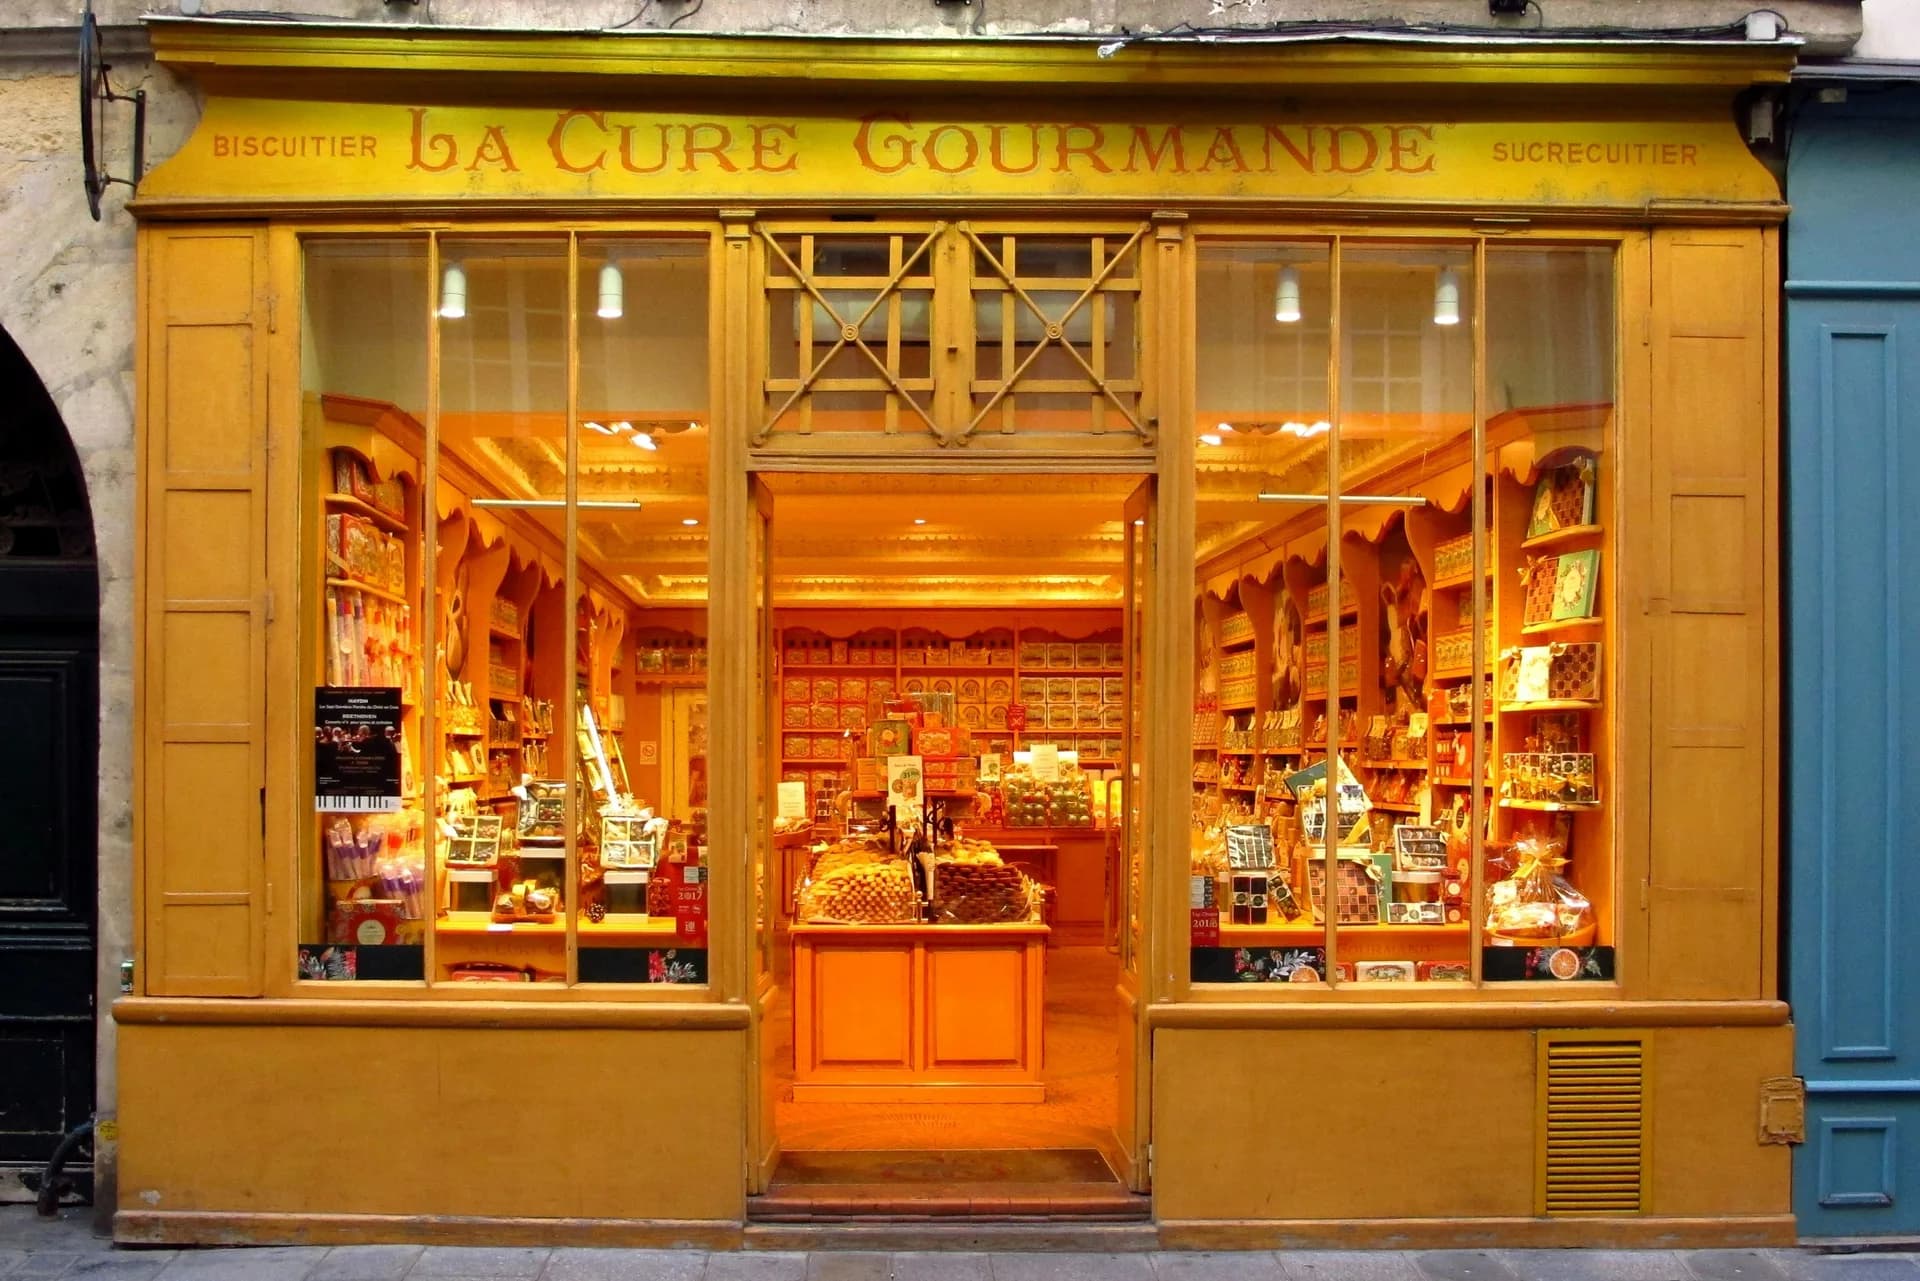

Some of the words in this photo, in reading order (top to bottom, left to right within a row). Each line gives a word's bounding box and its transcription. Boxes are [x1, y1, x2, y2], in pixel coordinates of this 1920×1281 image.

[213, 134, 377, 158] BISCUITIER
[405, 107, 520, 173] LA
[547, 108, 799, 174] CURE
[852, 111, 1437, 174] GOURMANDE
[1493, 141, 1698, 166] SUCRECUITIER
